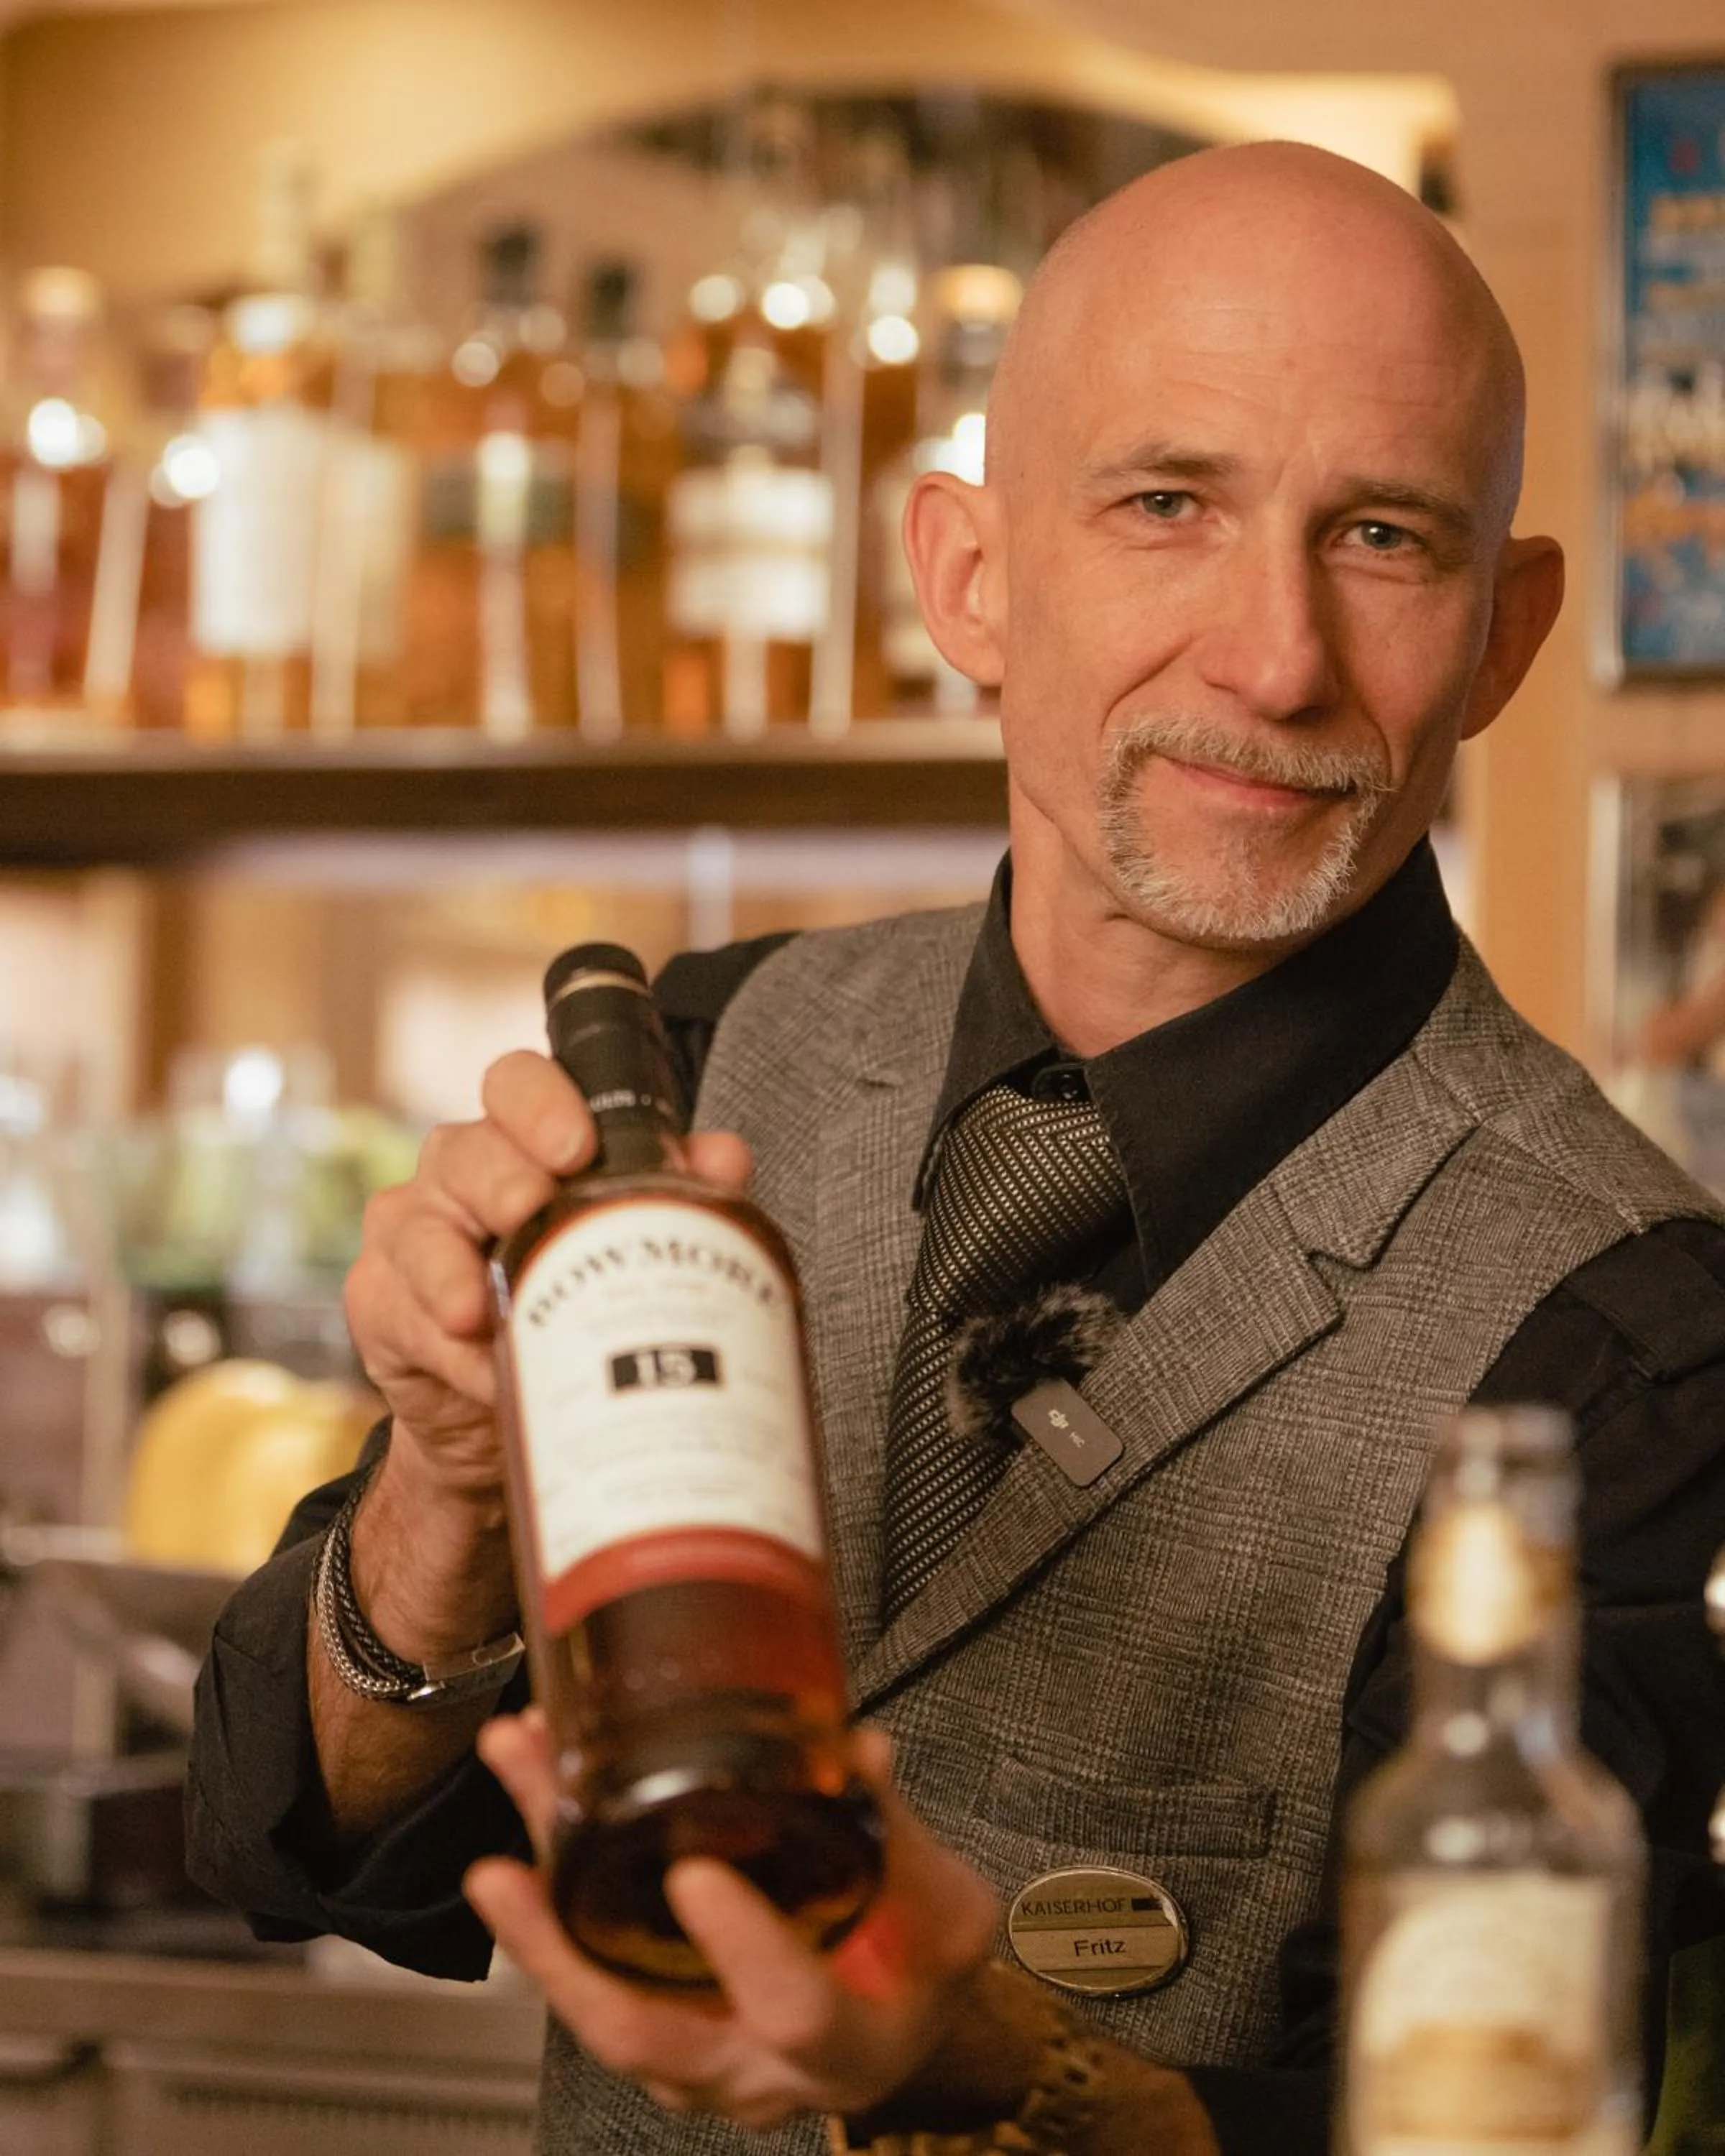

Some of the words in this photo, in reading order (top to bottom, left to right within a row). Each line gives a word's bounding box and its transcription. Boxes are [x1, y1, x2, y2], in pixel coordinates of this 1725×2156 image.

[637, 1349, 697, 1388] 15
[1021, 1898, 1126, 1916] KAISERHOF
[1073, 1940, 1128, 1957] Fritz
